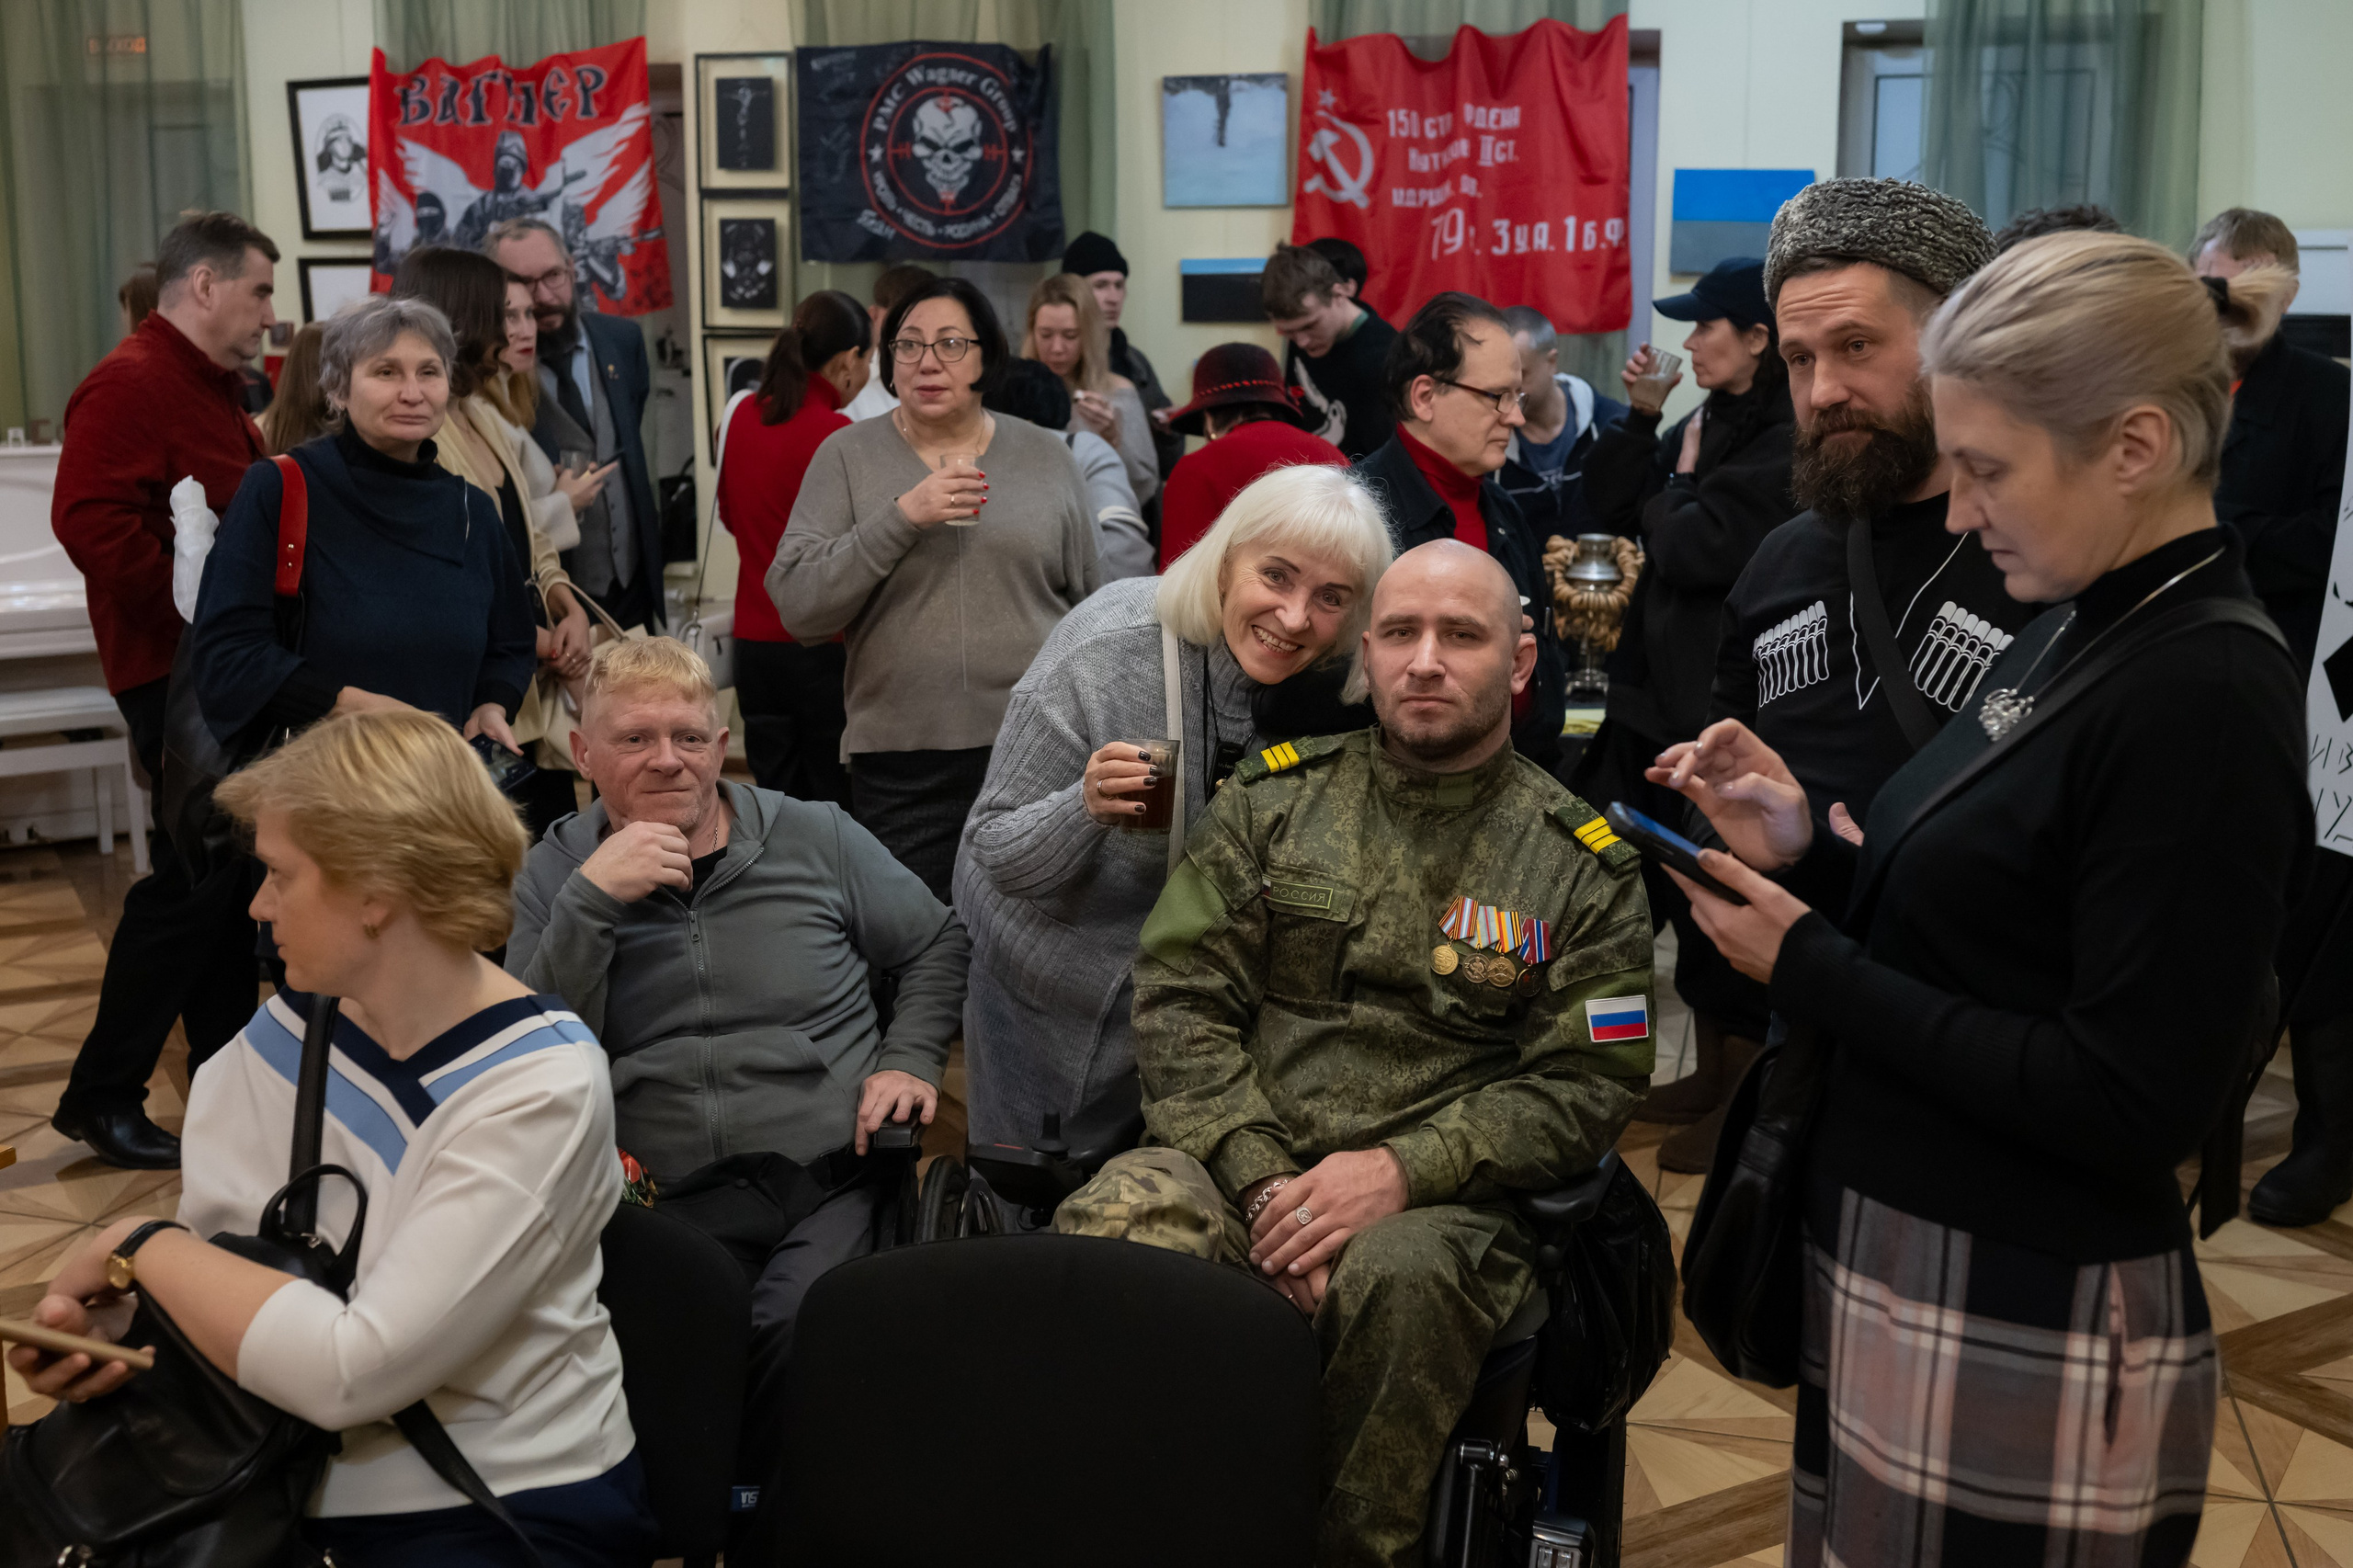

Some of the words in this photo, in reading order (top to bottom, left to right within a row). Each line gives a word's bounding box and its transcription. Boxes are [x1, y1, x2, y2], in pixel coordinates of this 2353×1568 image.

[872, 82, 905, 132] PMC
[904, 64, 980, 86] Wagner
[979, 75, 1018, 133] Group
[1272, 886, 1326, 903] РОССИЯ
